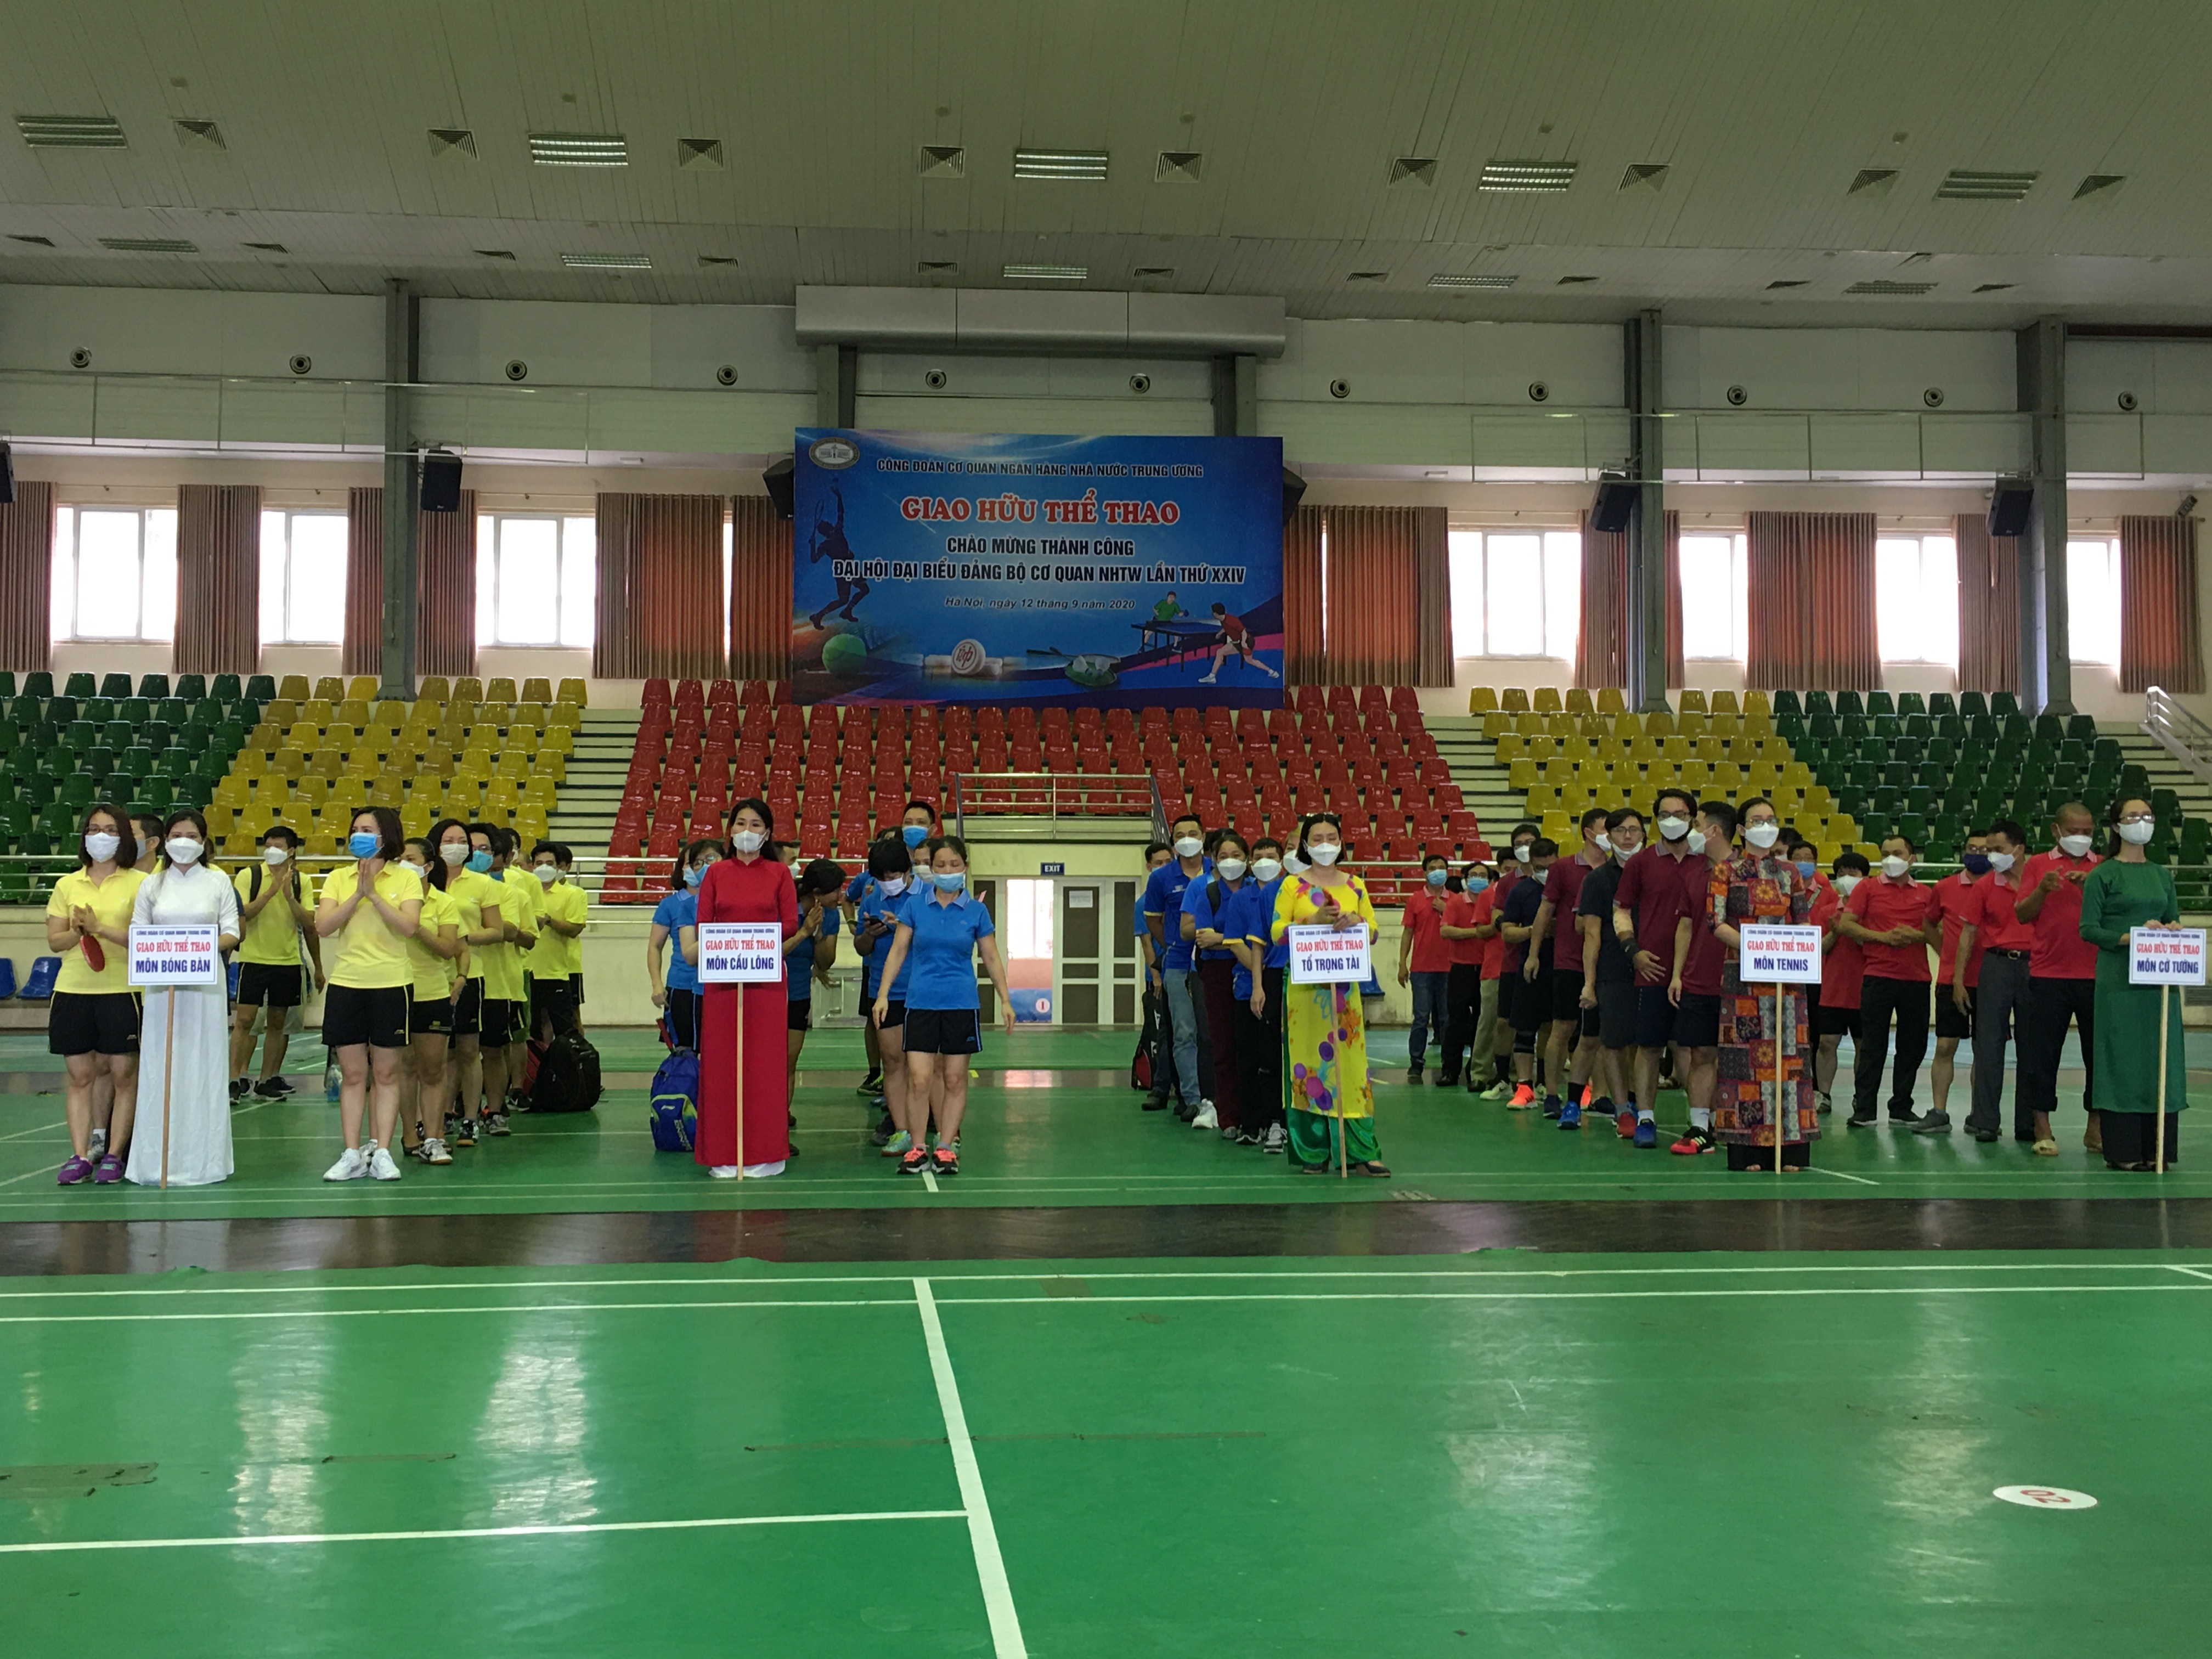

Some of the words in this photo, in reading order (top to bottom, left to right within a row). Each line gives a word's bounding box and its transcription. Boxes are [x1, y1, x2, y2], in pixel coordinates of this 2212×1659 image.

[878, 457, 909, 472] CÔNG
[912, 459, 944, 472] ĐOÀN
[947, 461, 963, 473] CƠ
[966, 462, 997, 475] QUAN
[1000, 462, 1032, 475] NGÂN
[1035, 462, 1066, 476] HÀNG
[1070, 462, 1094, 476] NHÀ
[1097, 462, 1128, 477] NƯỚC
[1131, 465, 1168, 477] TRUNG
[1171, 464, 1203, 477] ƯƠNG
[901, 497, 970, 520] GIAO
[977, 494, 1037, 522] HỮU
[1043, 488, 1097, 523] THỂ
[1103, 501, 1179, 524] THAO
[947, 535, 987, 554] CHÀO
[991, 535, 1036, 555] MỪNG
[1040, 537, 1089, 555] THÀNH
[1093, 537, 1134, 556] CÔNG
[833, 561, 859, 580] ĐẠI
[864, 558, 889, 581] HỘI
[893, 562, 918, 582] ĐẠI
[922, 557, 957, 579] BIỂU
[961, 558, 1002, 580] ĐẢNG
[1006, 561, 1026, 584] BỘ
[1030, 563, 1051, 581] CƠ
[1055, 565, 1094, 583] QUAN
[1099, 566, 1142, 582] NHTW
[1179, 563, 1209, 583] THỨ
[1211, 567, 1245, 584] XXIV
[1021, 598, 1034, 607] 12
[1036, 599, 1069, 611] tháng
[1071, 599, 1079, 608] 9
[1109, 599, 1135, 609] 2020
[1044, 865, 1061, 873] EXIT
[136, 941, 155, 952] GIAO
[156, 939, 172, 952] HỮU
[174, 936, 189, 952] THỂ
[190, 941, 211, 952] THAO
[706, 940, 723, 950] GIAO
[724, 937, 740, 950] HỮU
[741, 934, 755, 950] THỂ
[756, 939, 775, 950] THAO
[1296, 941, 1313, 952] GIAO
[1314, 938, 1329, 951] HỮU
[1330, 935, 1344, 951] THỂ
[1345, 939, 1363, 950] THAO
[1747, 940, 1764, 951] GIAO
[1765, 938, 1780, 951] HỮU
[1781, 936, 1795, 952] THỂ
[1796, 941, 1815, 952] THAO
[2136, 943, 2152, 953] GIAO
[2154, 941, 2168, 953] HỮU
[2169, 939, 2181, 954] THỂ
[2182, 944, 2200, 955] THAO
[136, 957, 159, 973] MÔN
[161, 957, 188, 973] BÓNG
[190, 957, 211, 973] BÀN
[706, 955, 728, 970] MÔN
[751, 954, 774, 970] LÔNG
[1301, 953, 1313, 972] TỔ
[1314, 957, 1344, 974] TRỌNG
[1346, 954, 1360, 970] TÀI
[1753, 955, 1774, 970] MÔN
[1776, 958, 1809, 972] TENNIS
[2136, 957, 2157, 973] MÔN
[2158, 957, 2171, 973] CỜ
